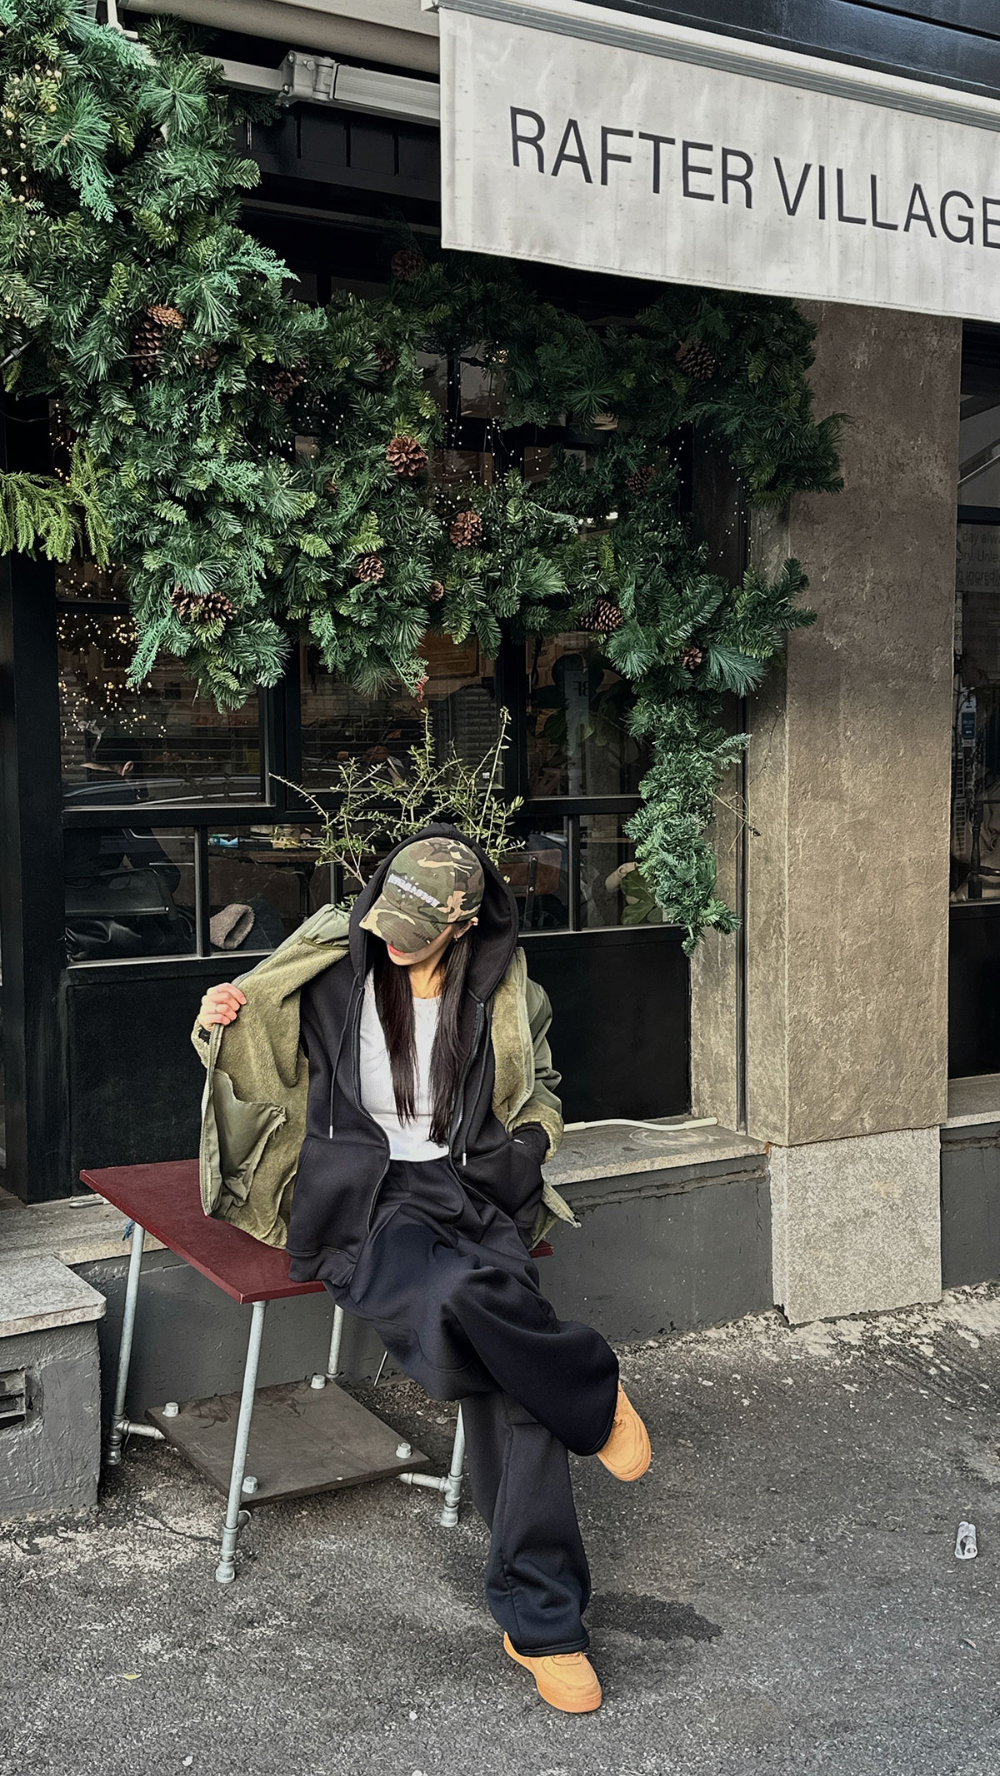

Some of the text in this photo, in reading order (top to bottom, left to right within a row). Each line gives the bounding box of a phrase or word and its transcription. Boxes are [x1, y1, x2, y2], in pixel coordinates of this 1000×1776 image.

[510, 105, 1000, 249] RAFTER VILLAGE
[980, 531, 1000, 545] alw
[965, 567, 1000, 583] ingredi
